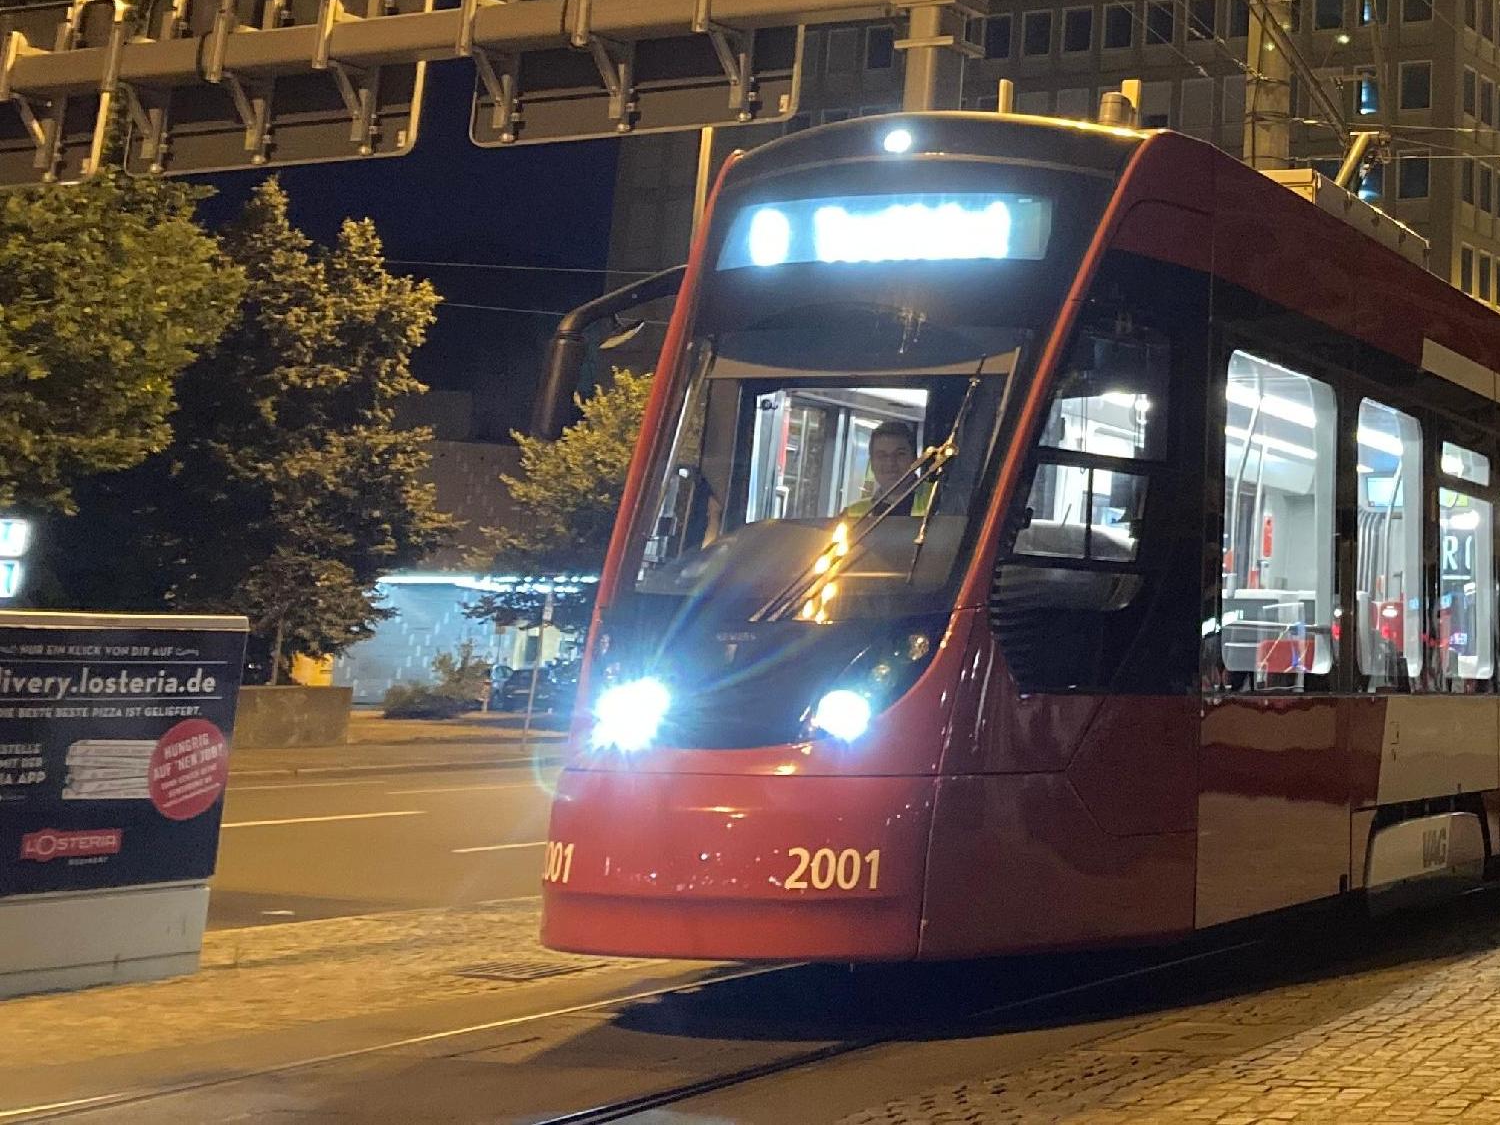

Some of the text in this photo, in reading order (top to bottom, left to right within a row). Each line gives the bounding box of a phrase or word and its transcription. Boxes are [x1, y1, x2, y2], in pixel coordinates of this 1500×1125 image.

[67, 645, 100, 655] KLICK
[105, 646, 129, 656] VON
[131, 646, 150, 656] DIR
[153, 646, 174, 656] AUF
[93, 707, 122, 717] PIZZA
[784, 847, 880, 890] 2001
